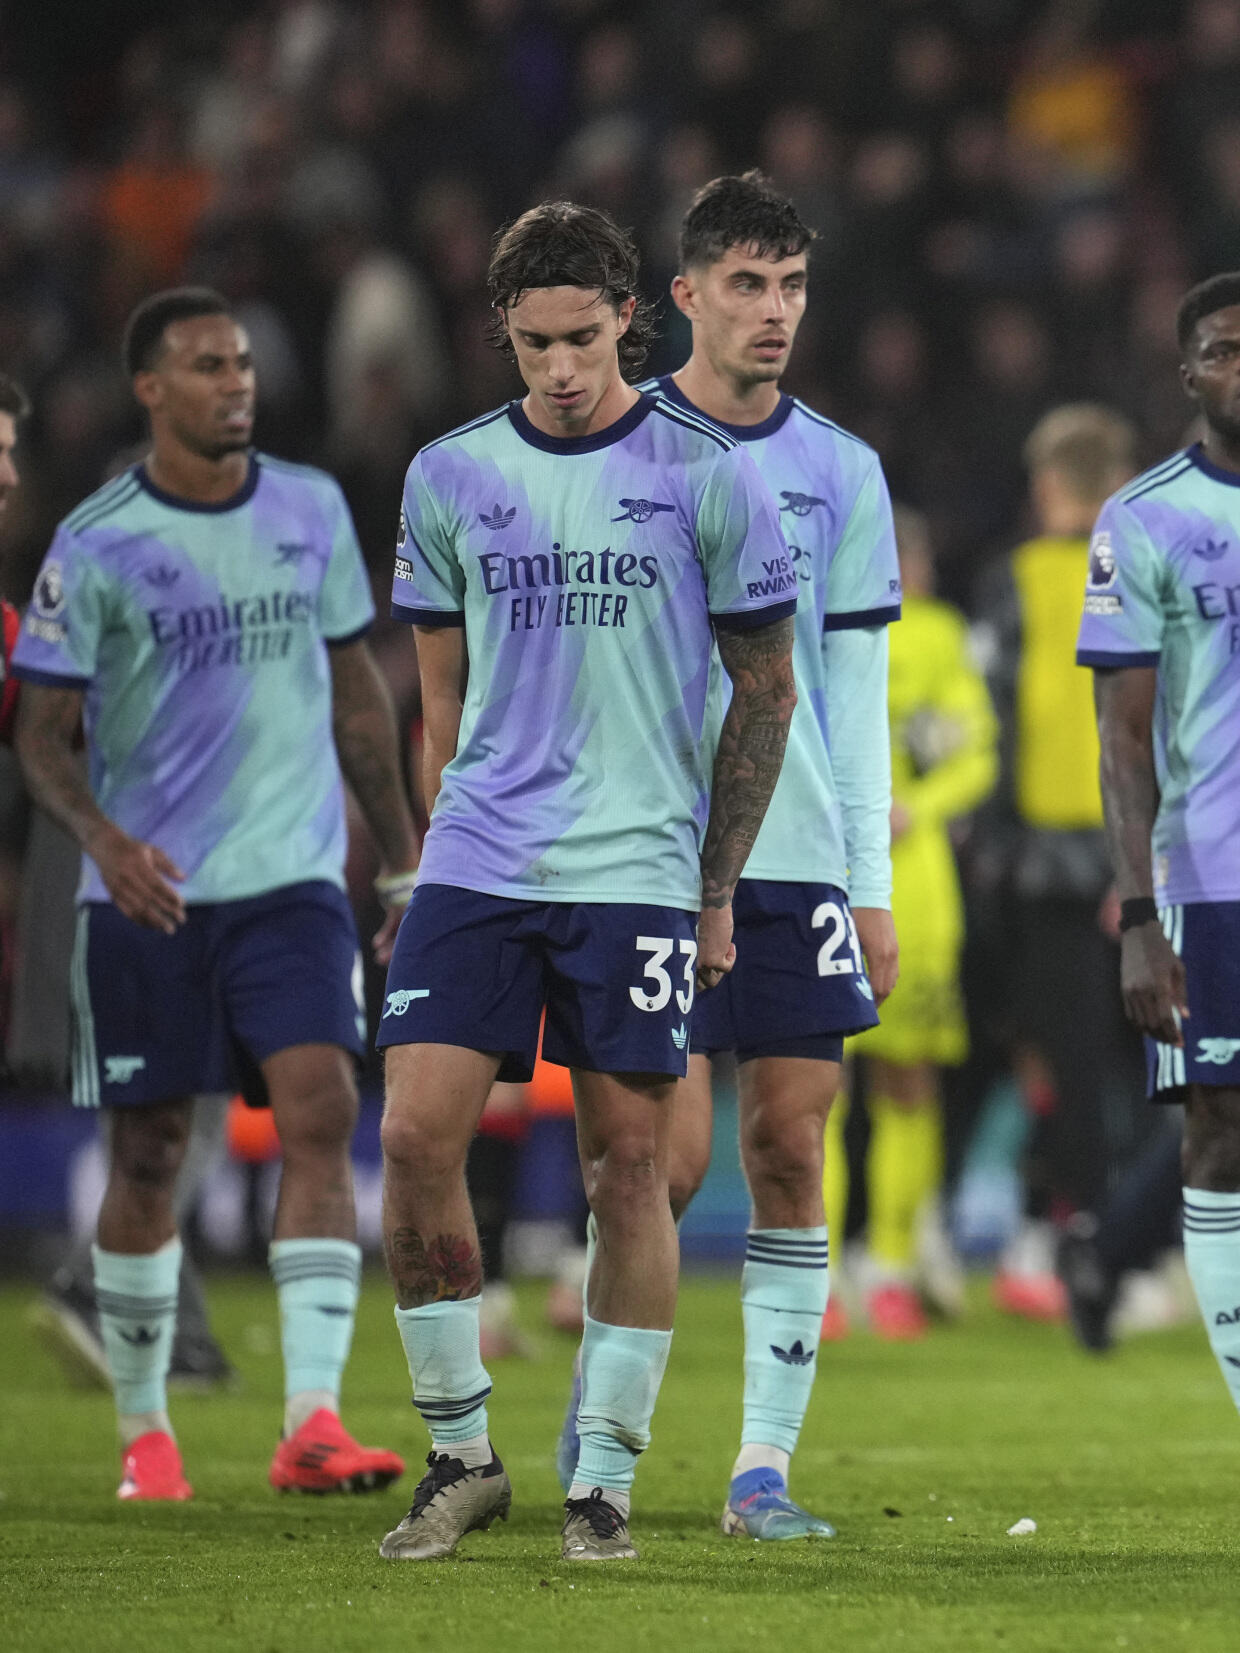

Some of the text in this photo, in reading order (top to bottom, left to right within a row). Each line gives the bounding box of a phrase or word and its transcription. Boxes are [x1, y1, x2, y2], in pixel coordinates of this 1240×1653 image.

[477, 542, 658, 595] Emirates
[510, 592, 628, 632] FLY BETTER
[629, 935, 698, 1015] 33
